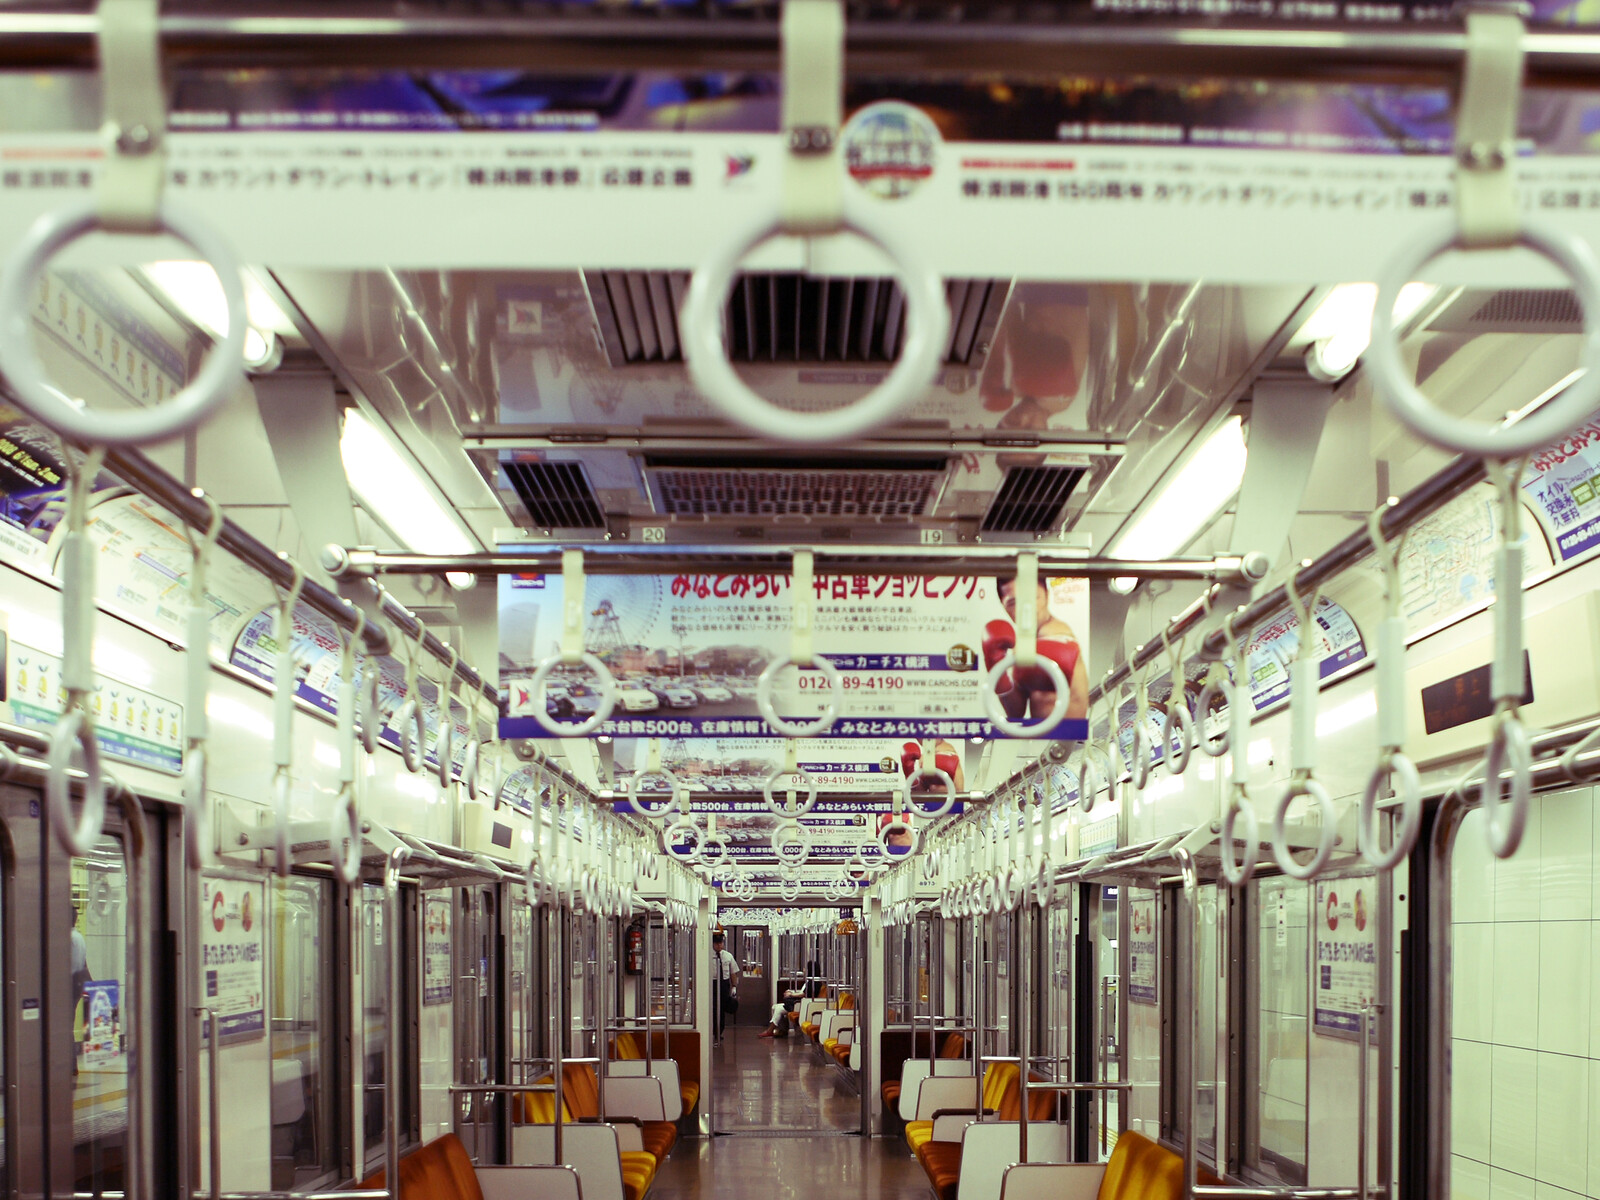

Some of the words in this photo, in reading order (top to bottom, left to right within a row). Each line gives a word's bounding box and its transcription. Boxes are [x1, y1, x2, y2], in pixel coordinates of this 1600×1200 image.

[644, 529, 664, 541] 20
[924, 530, 941, 541] 19
[671, 574, 986, 600] みなとみらい中古車ショッピング。
[857, 656, 930, 669] カーチス横浜
[798, 676, 904, 689] 01289-4190
[826, 764, 870, 772] カーチス横浜
